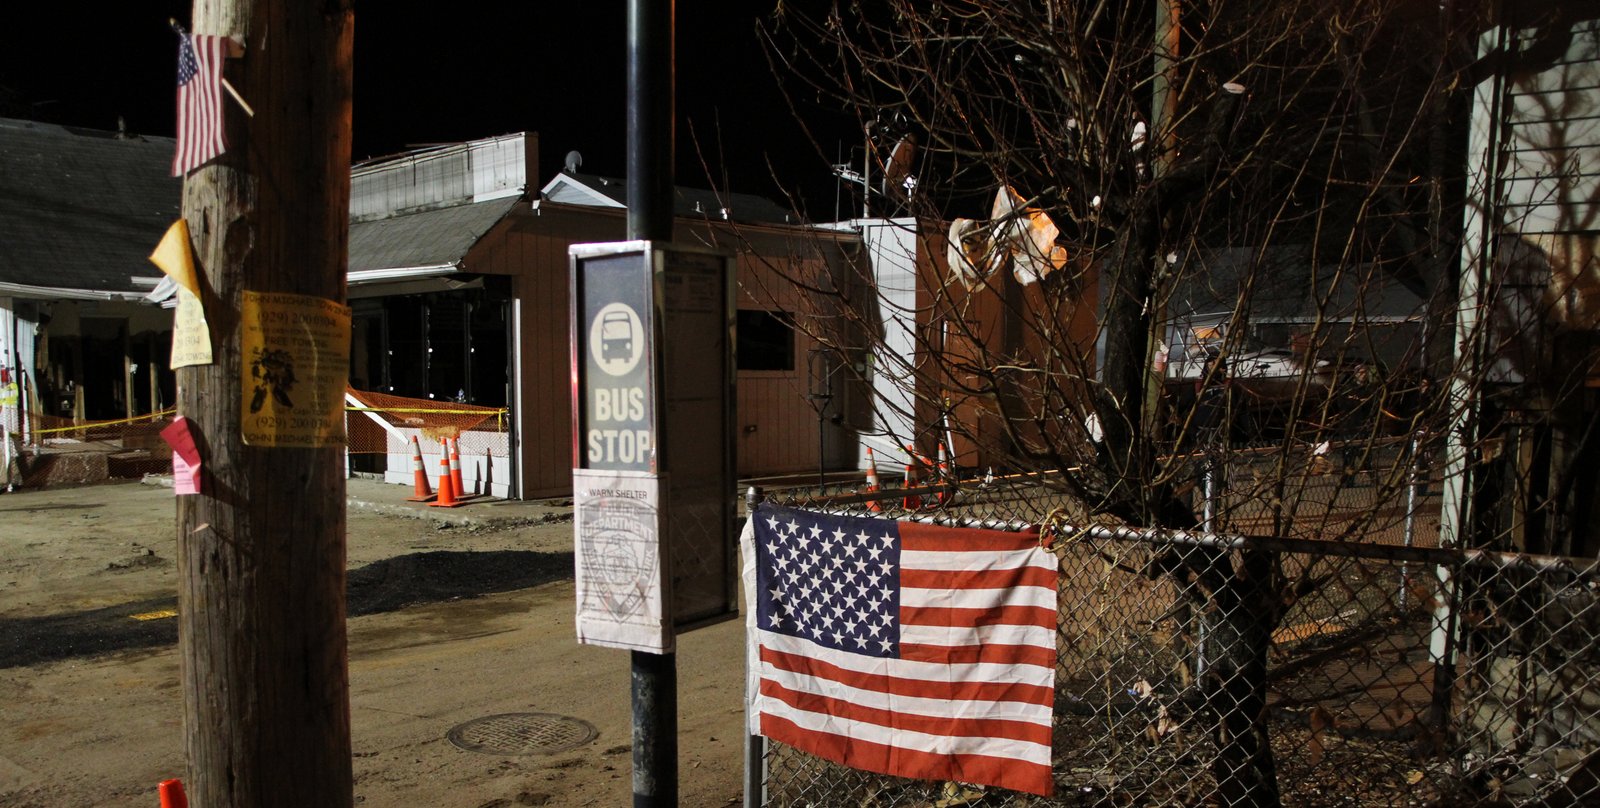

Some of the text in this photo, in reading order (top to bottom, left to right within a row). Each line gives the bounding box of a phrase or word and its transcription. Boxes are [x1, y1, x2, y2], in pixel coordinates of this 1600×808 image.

[272, 294, 312, 307] MICHAEL
[595, 387, 644, 422] BUS
[588, 429, 650, 463] STOP
[589, 488, 648, 500] WARM SHELTER
[583, 516, 655, 542] DEPARTMENT
